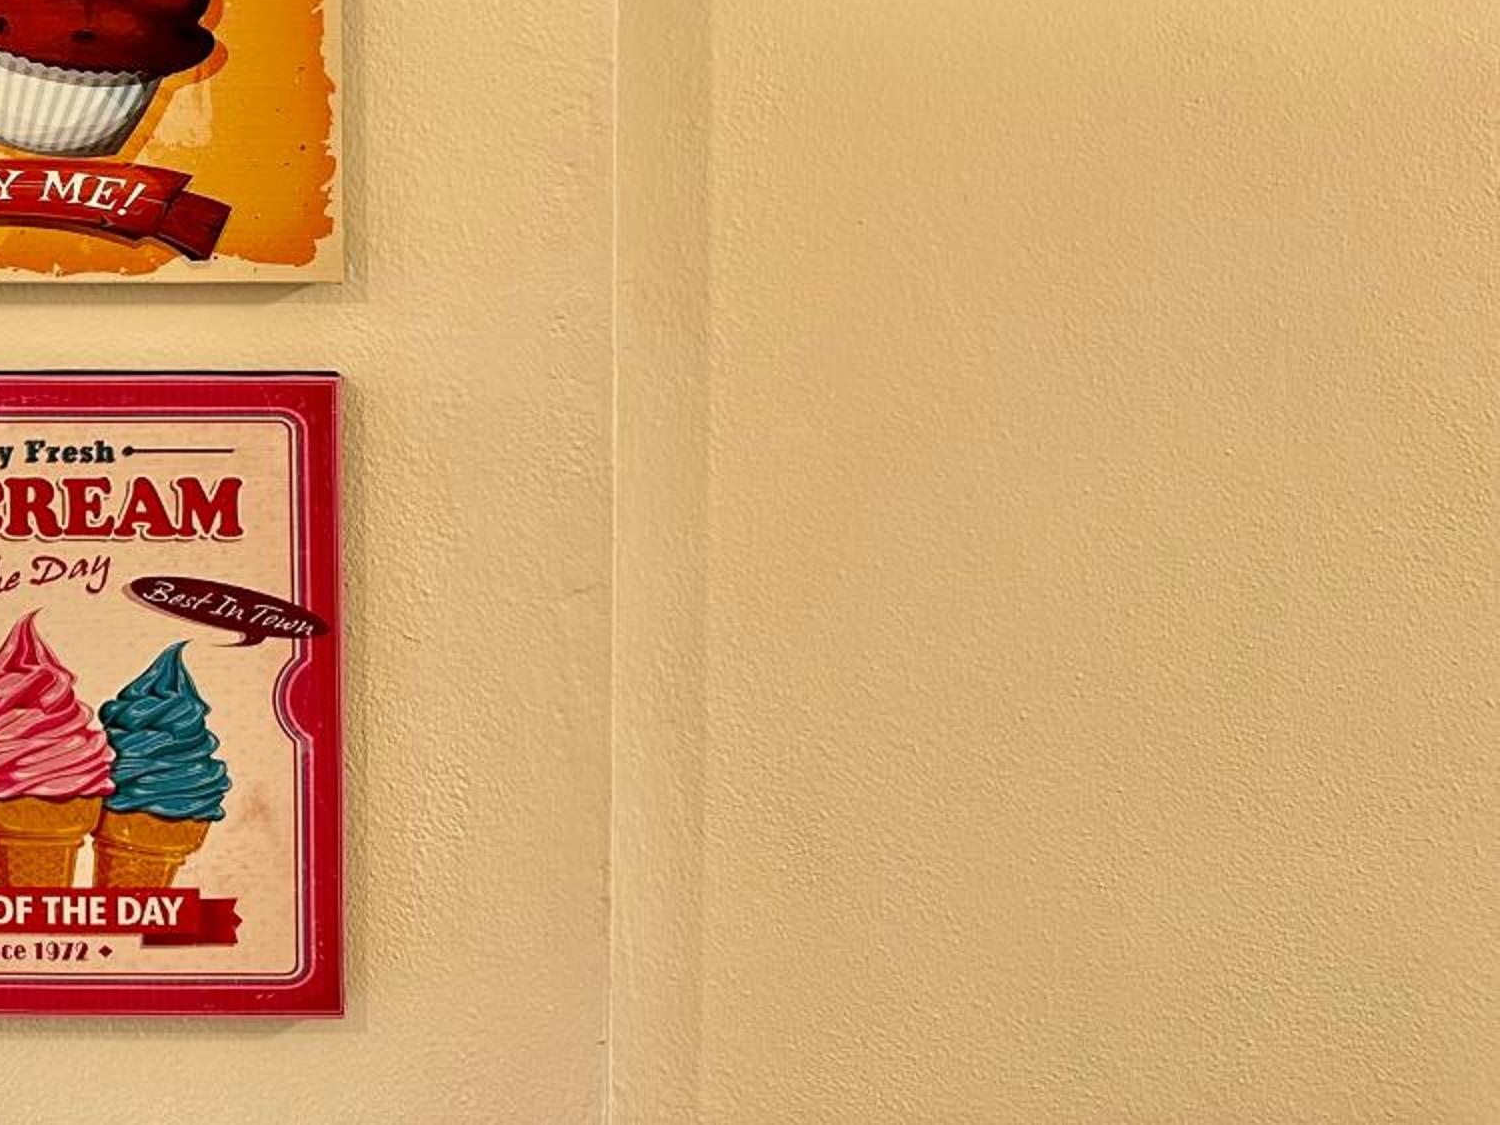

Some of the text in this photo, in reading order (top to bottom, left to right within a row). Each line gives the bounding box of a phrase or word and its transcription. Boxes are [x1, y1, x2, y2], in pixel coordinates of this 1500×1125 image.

[41, 170, 147, 216] ME!
[25, 440, 115, 463] Fresh
[30, 555, 111, 594] Day
[143, 580, 314, 636] Best In Town
[42, 896, 107, 925] THE
[117, 896, 184, 926] DAY
[34, 942, 89, 962] 1972
